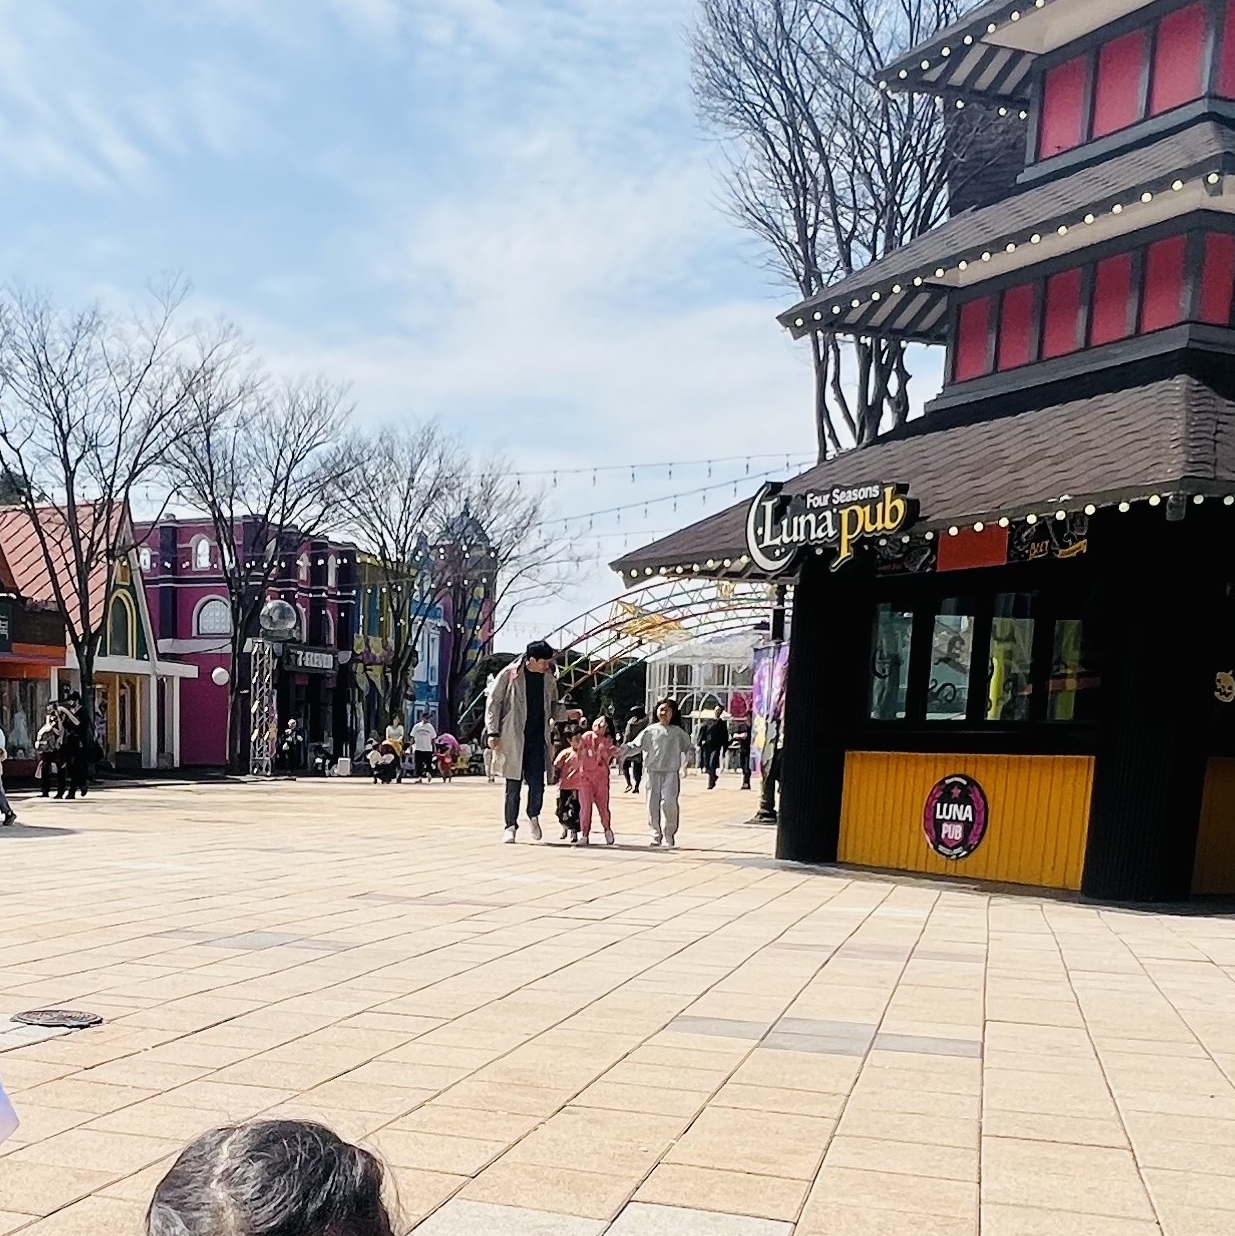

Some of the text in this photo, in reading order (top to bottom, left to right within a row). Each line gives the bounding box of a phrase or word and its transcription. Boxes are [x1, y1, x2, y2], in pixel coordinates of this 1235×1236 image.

[807, 484, 880, 509] Four Seasons
[758, 486, 905, 572] Luna pub
[935, 802, 973, 822] LUNA
[941, 822, 963, 840] PUB
